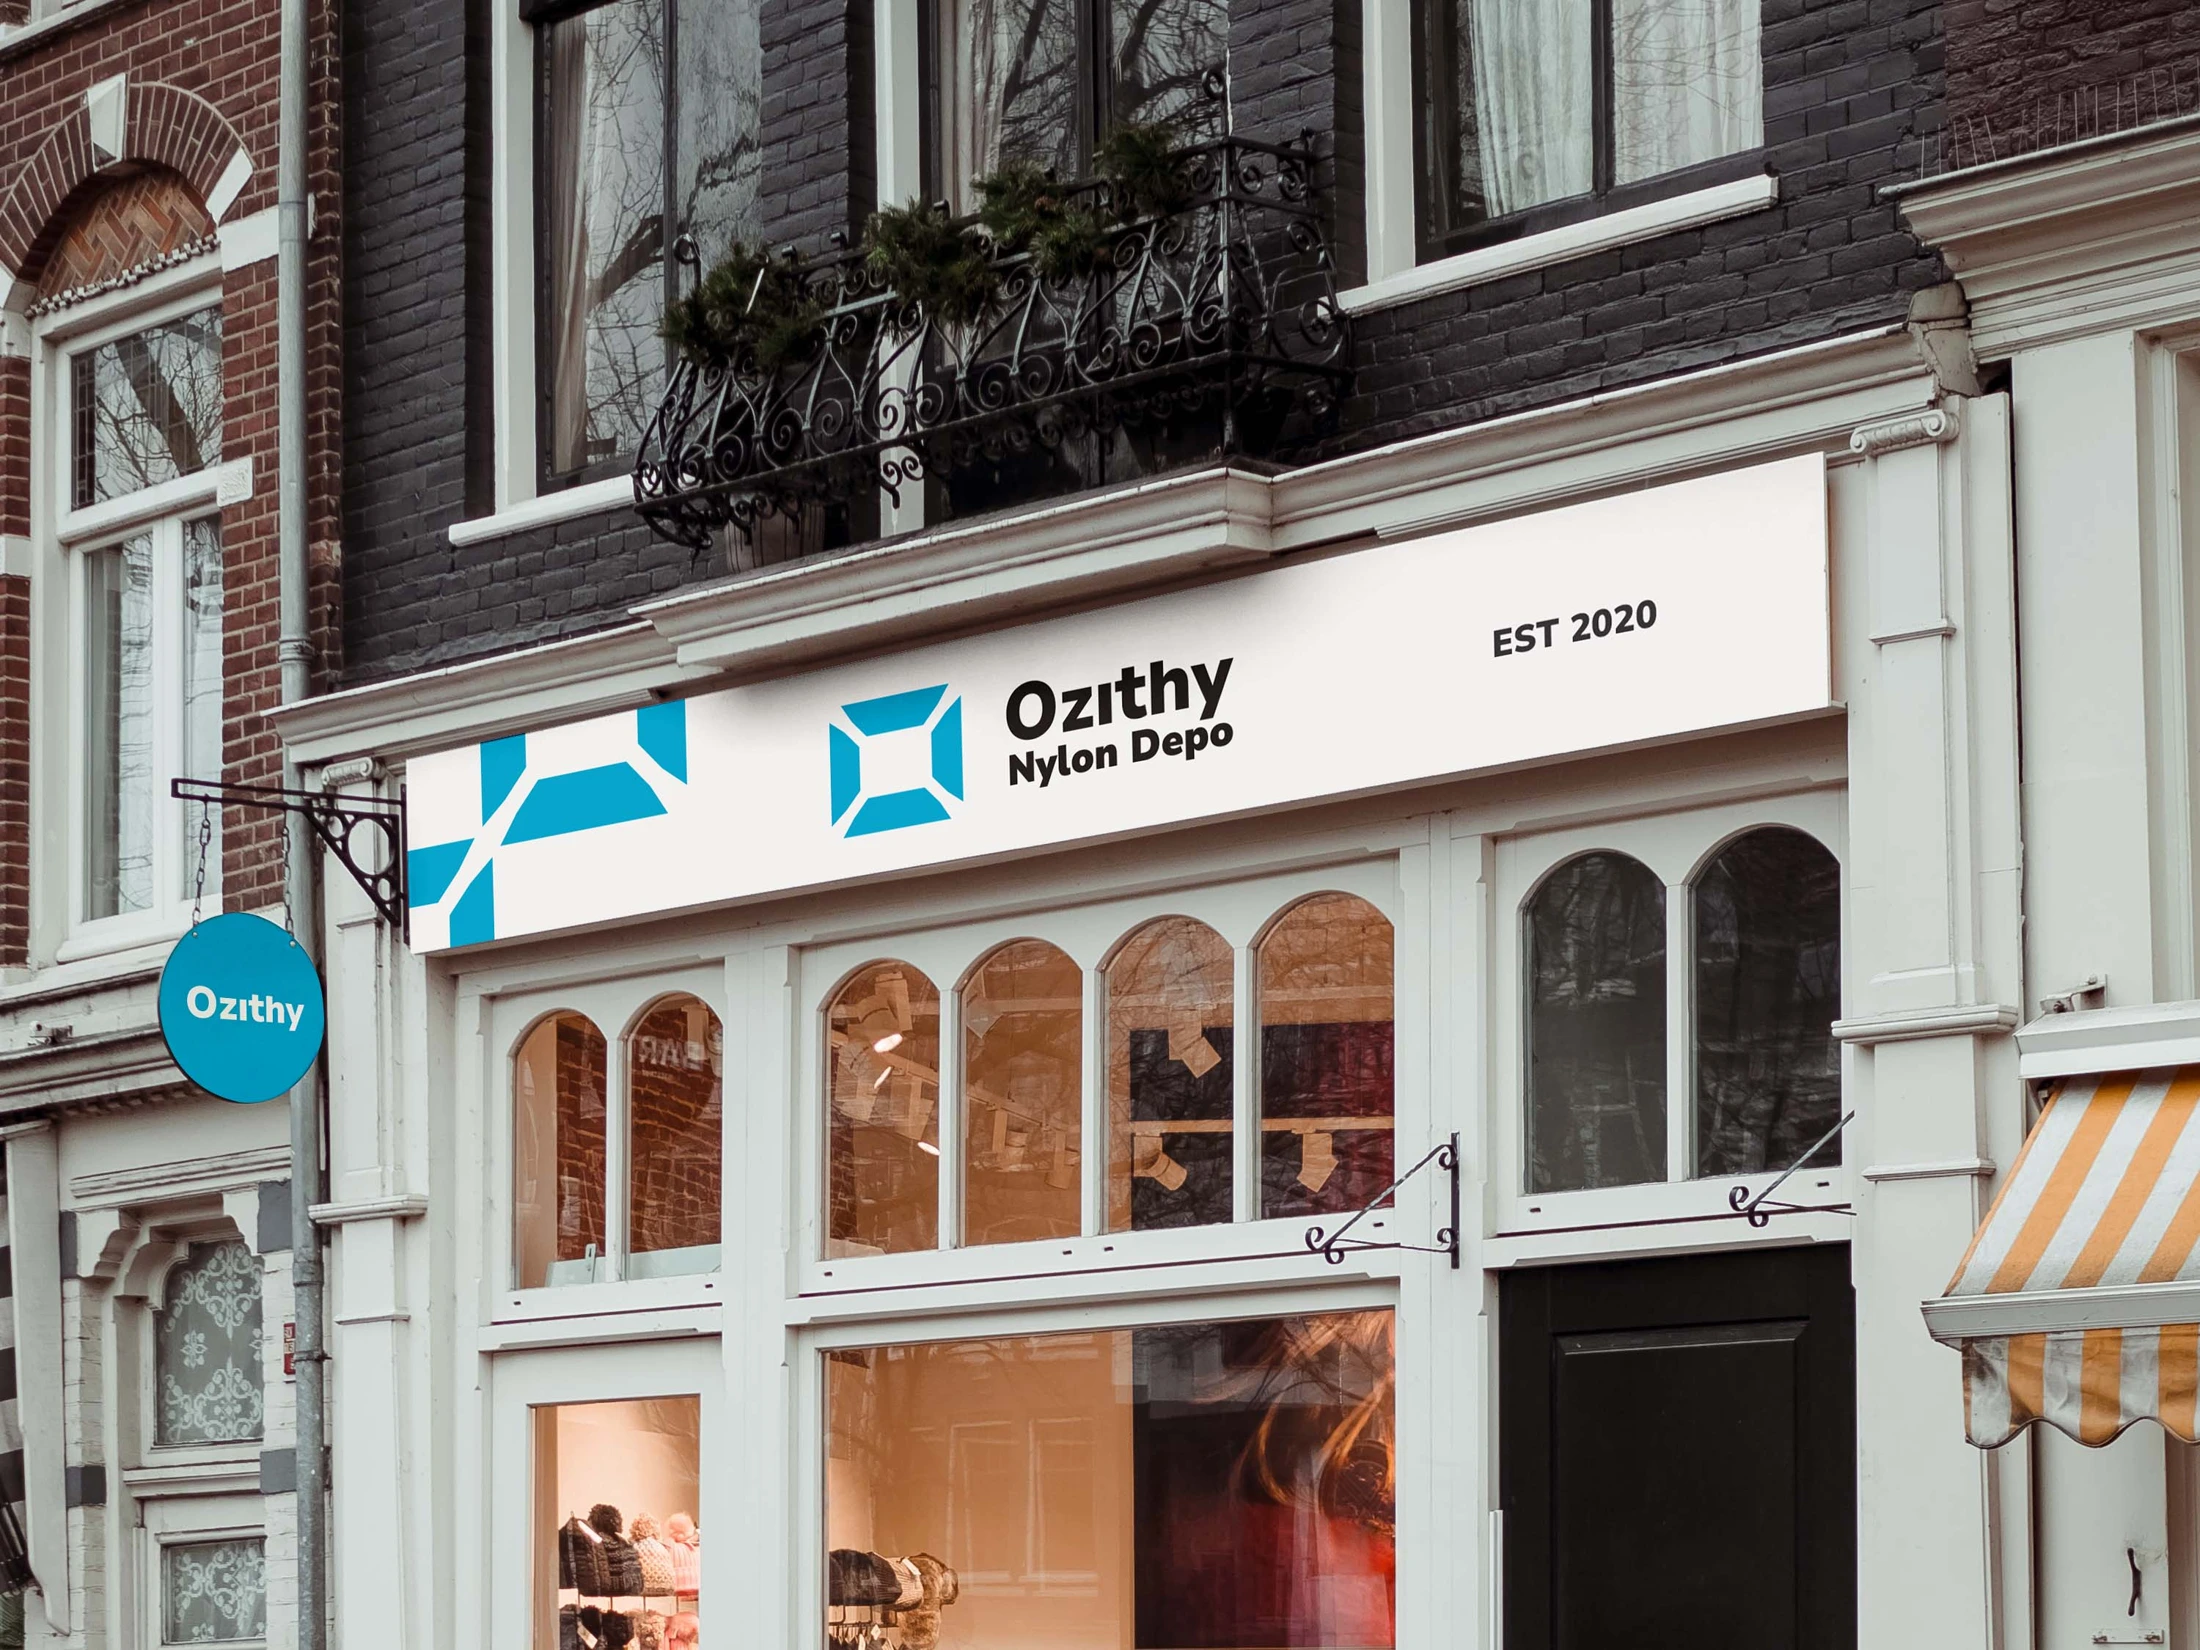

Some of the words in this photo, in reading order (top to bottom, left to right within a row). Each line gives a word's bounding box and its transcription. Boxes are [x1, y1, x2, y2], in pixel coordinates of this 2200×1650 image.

[1493, 617, 1560, 658] EST
[1570, 599, 1657, 643] 2020
[1008, 743, 1118, 789] Nylon
[1131, 722, 1234, 763] Depo
